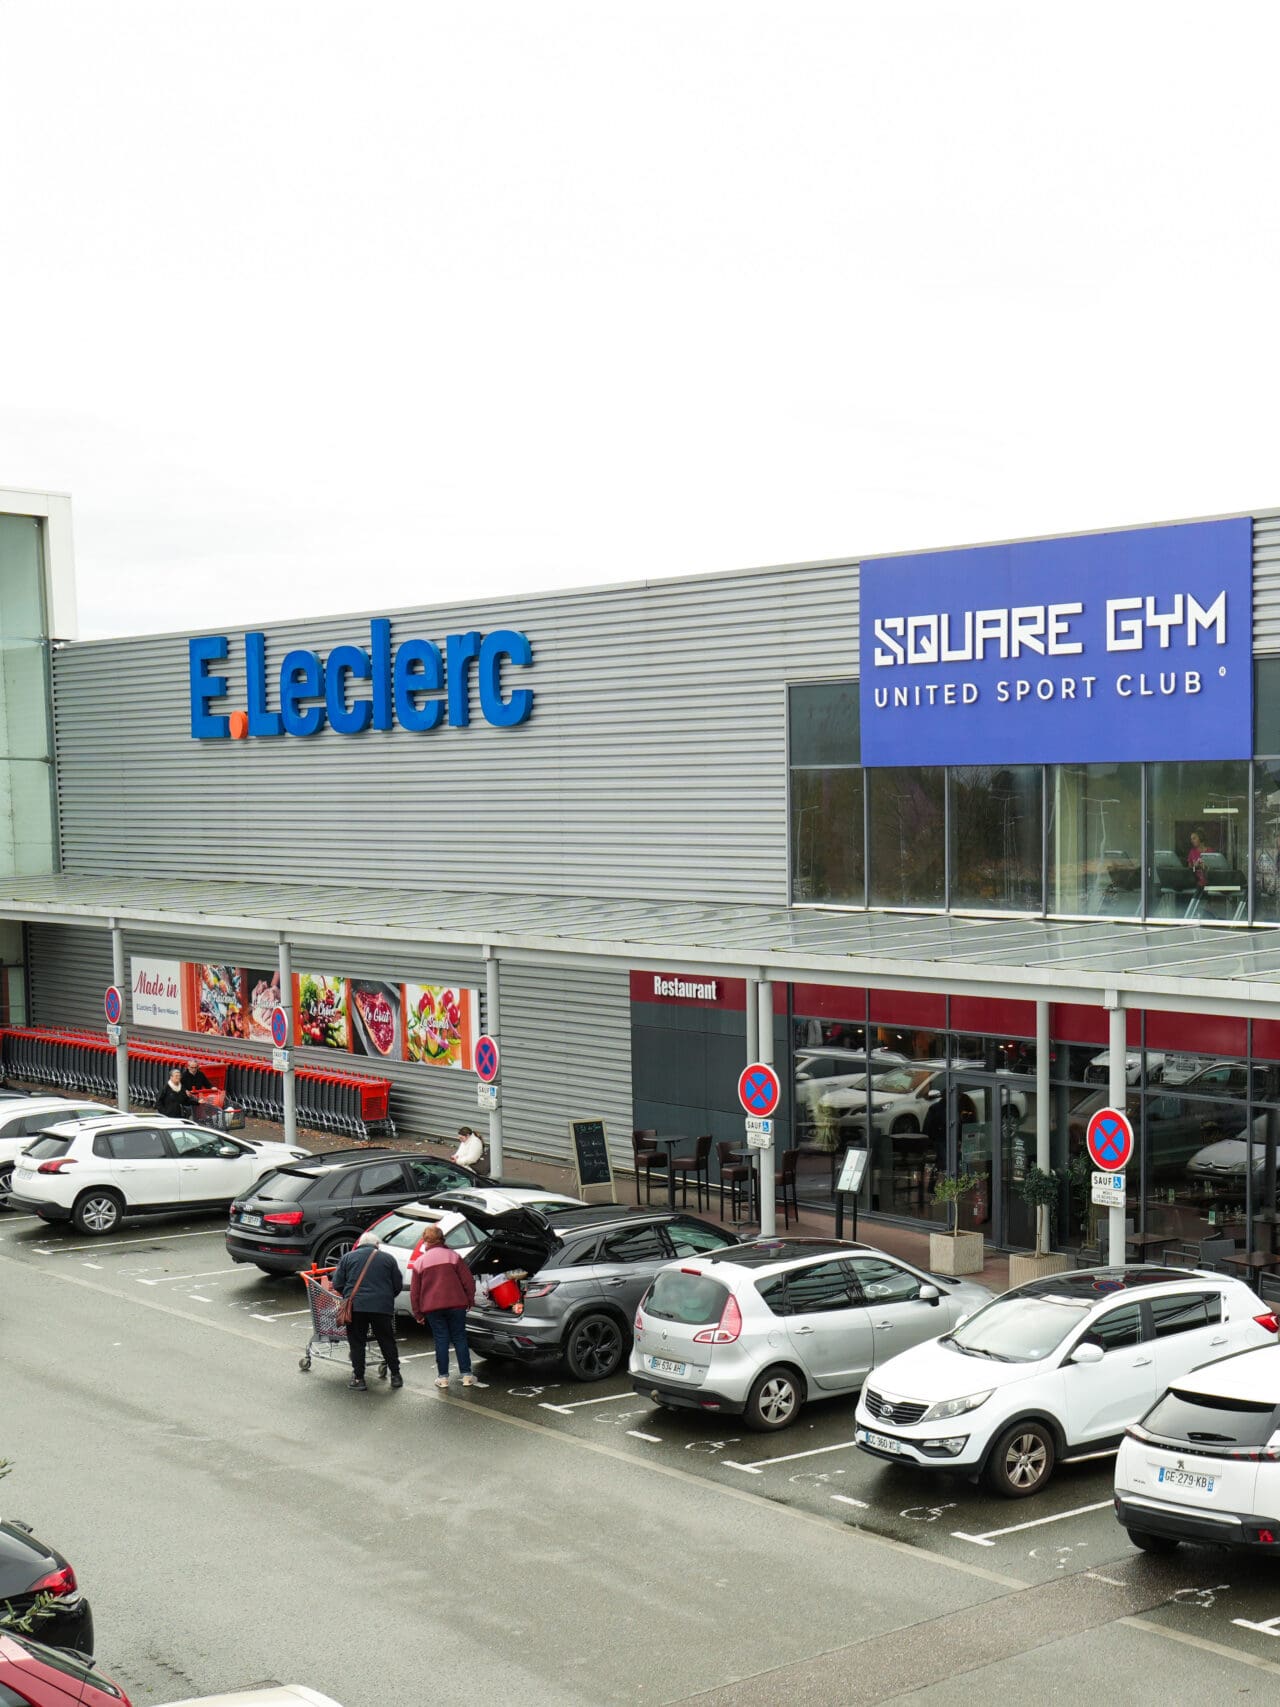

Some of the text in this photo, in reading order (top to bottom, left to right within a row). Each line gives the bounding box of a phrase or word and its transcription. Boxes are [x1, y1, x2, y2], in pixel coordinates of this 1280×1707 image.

[874, 590, 1226, 666] SQUARE GYM
[189, 618, 534, 740] E.Leclerc
[874, 683, 979, 709] UNITED
[997, 676, 1097, 702] SPORT
[1116, 671, 1202, 697] CLUB
[134, 970, 164, 998] Made
[166, 977, 178, 999] in
[654, 975, 717, 1001] Restaurant
[747, 1121, 761, 1130] SAUF
[1093, 1176, 1112, 1186] SAUF
